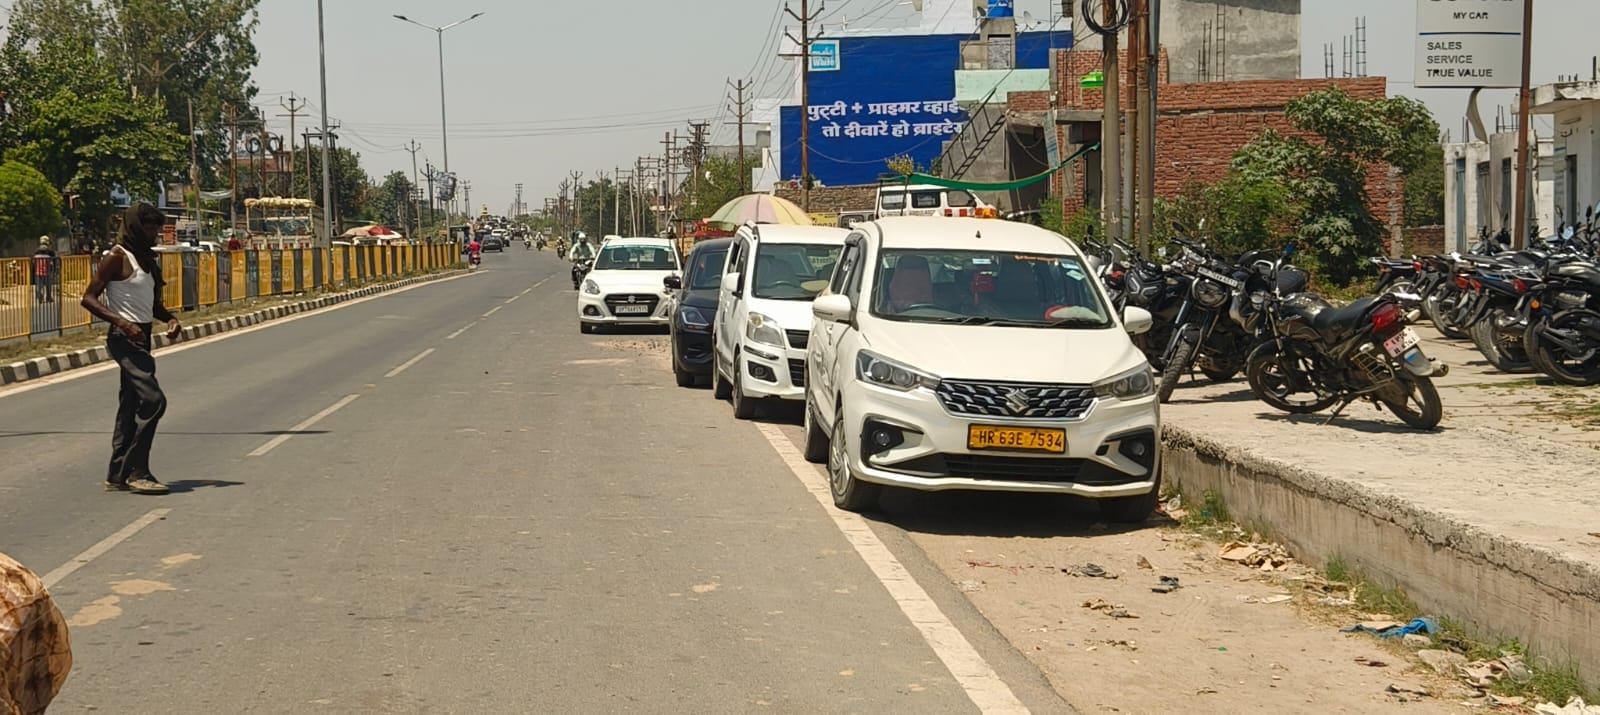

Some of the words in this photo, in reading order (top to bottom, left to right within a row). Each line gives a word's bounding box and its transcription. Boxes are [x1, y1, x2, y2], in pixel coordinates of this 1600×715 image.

[1427, 42, 1462, 50] SALES
[1426, 55, 1473, 64] SERVICE
[1426, 69, 1455, 77] TRUE
[1457, 69, 1493, 77] VALUE
[868, 102, 920, 115] प्राइमर
[821, 122, 841, 137] तो
[843, 120, 888, 138] दीवारें
[891, 120, 910, 137] हो
[979, 430, 995, 444] HR
[999, 431, 1023, 446] 63E
[1029, 432, 1062, 448] 7534
